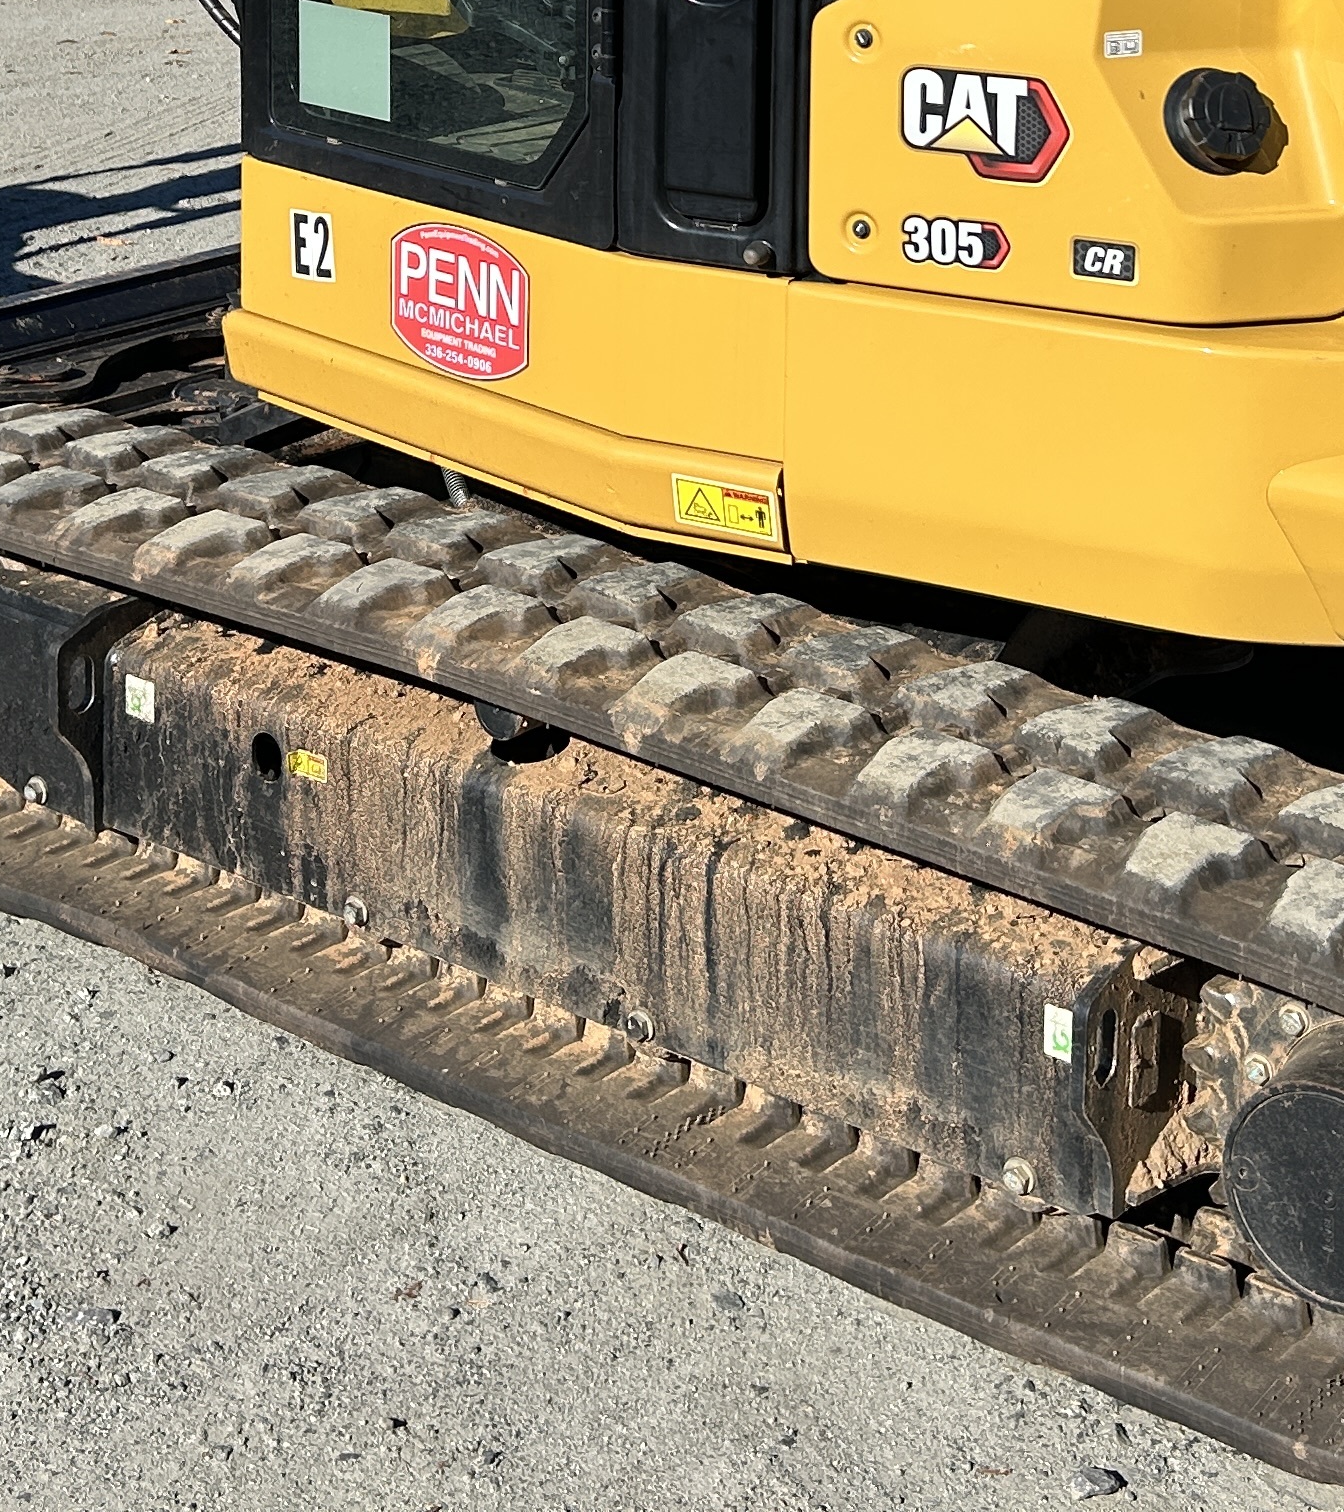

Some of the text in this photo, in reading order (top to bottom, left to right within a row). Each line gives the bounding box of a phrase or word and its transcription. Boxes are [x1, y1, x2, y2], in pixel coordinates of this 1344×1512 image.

[902, 67, 1029, 157] CAT
[293, 212, 333, 279] E2
[902, 215, 984, 267] 305
[1083, 245, 1125, 276] CR
[399, 240, 521, 327] PENN
[398, 297, 521, 350] MCMICHAEL
[420, 327, 497, 358] EQUIPMENT TRADING
